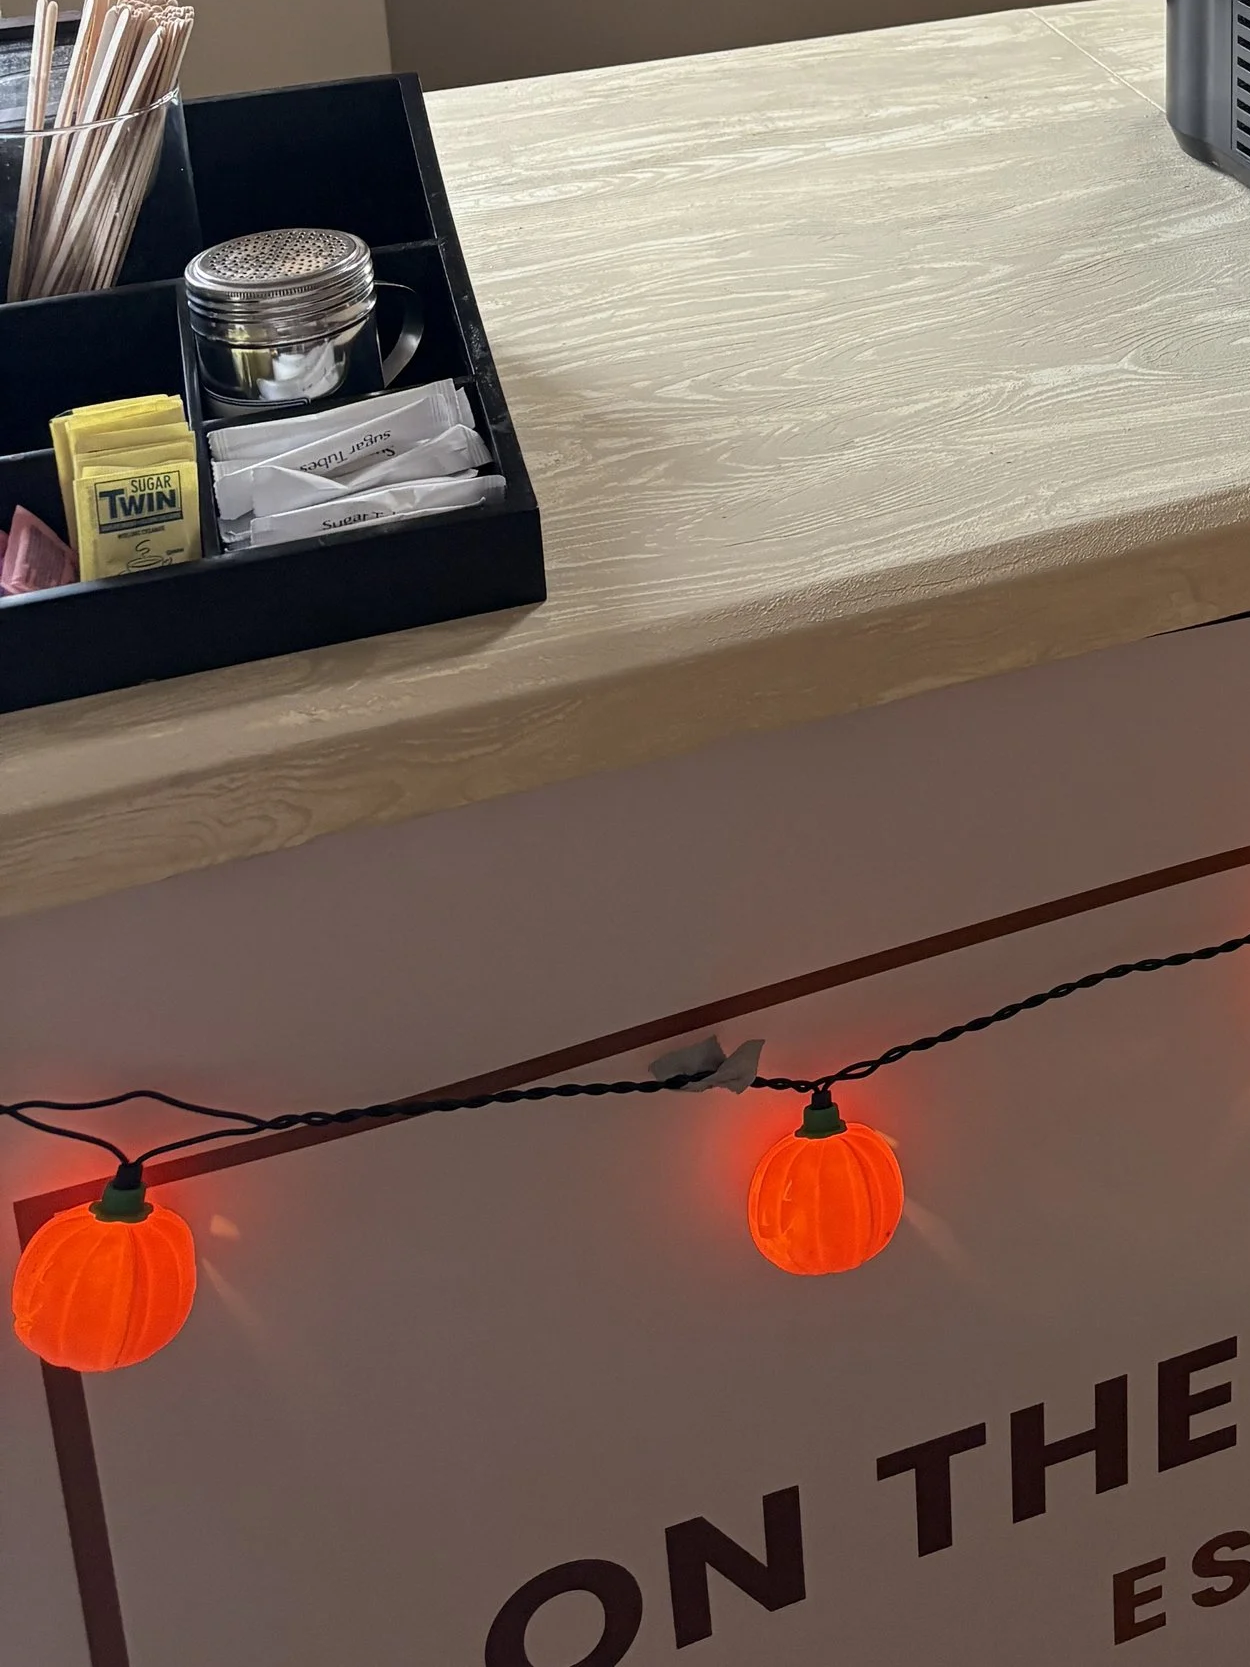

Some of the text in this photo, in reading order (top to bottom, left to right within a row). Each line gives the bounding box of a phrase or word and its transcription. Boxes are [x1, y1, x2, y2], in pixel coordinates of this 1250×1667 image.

[300, 451, 348, 473] Tubes
[131, 475, 172, 493] SUGAR
[484, 1484, 807, 1667] ON
[876, 1336, 1238, 1557] THE
